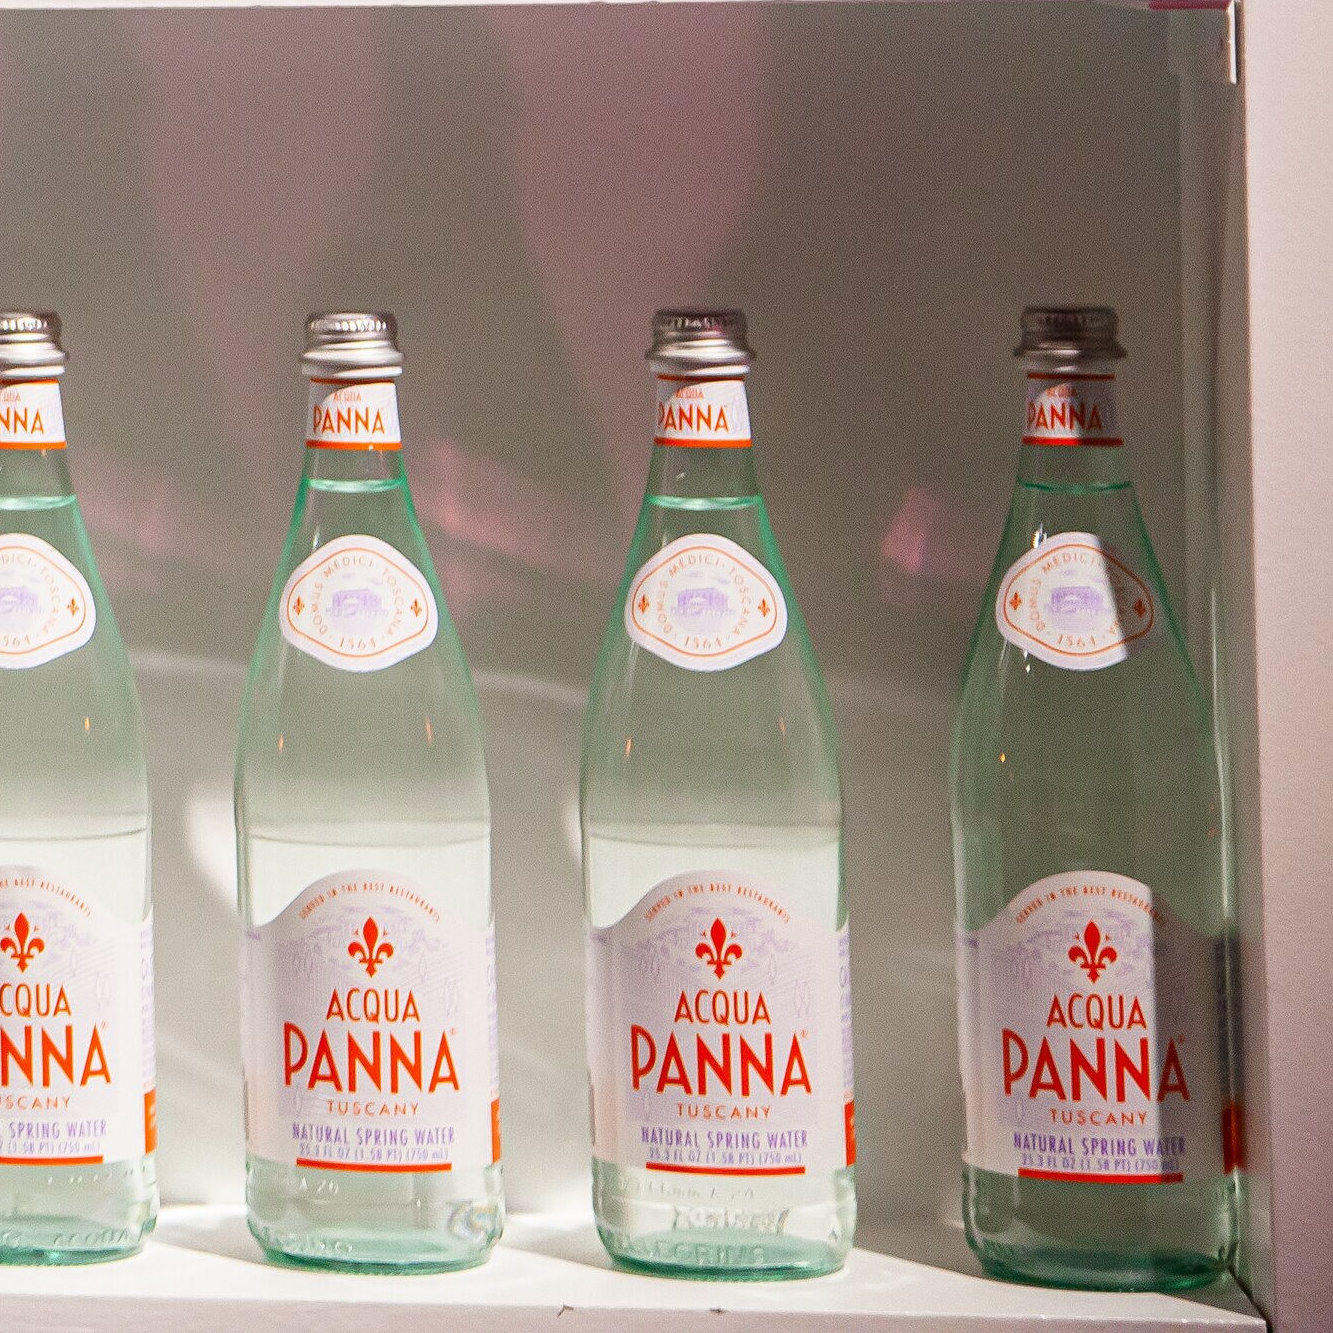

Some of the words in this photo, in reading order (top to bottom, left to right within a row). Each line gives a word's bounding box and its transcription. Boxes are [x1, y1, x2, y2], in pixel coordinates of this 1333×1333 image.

[314, 406, 384, 434] PANNA
[659, 404, 728, 431] PANNA
[323, 554, 374, 578] MEDICI
[338, 636, 376, 650] 1564
[326, 988, 420, 1020] ACQUA
[675, 990, 771, 1023] ACQUA
[1047, 993, 1146, 1027] ACQUA
[284, 1020, 459, 1094] PANNA
[631, 1023, 811, 1097] PANNA
[1003, 1026, 1190, 1103] PANNA
[328, 1100, 418, 1116] TUSCANY
[678, 1103, 770, 1120] TUSCANY
[1050, 1109, 1145, 1126] TUSCANY
[8, 1122, 61, 1139] SPRING
[64, 1121, 109, 1138] WATER
[290, 1126, 350, 1143] NATURAL
[354, 1129, 409, 1146] SPRING
[413, 1127, 456, 1145] WATER
[639, 1128, 701, 1147] NATURAL
[705, 1131, 762, 1149] SPRING
[765, 1130, 809, 1148] WATER
[1012, 1134, 1075, 1153] NATURAL
[1079, 1138, 1138, 1156] SPRING
[1142, 1139, 1187, 1156] WATER
